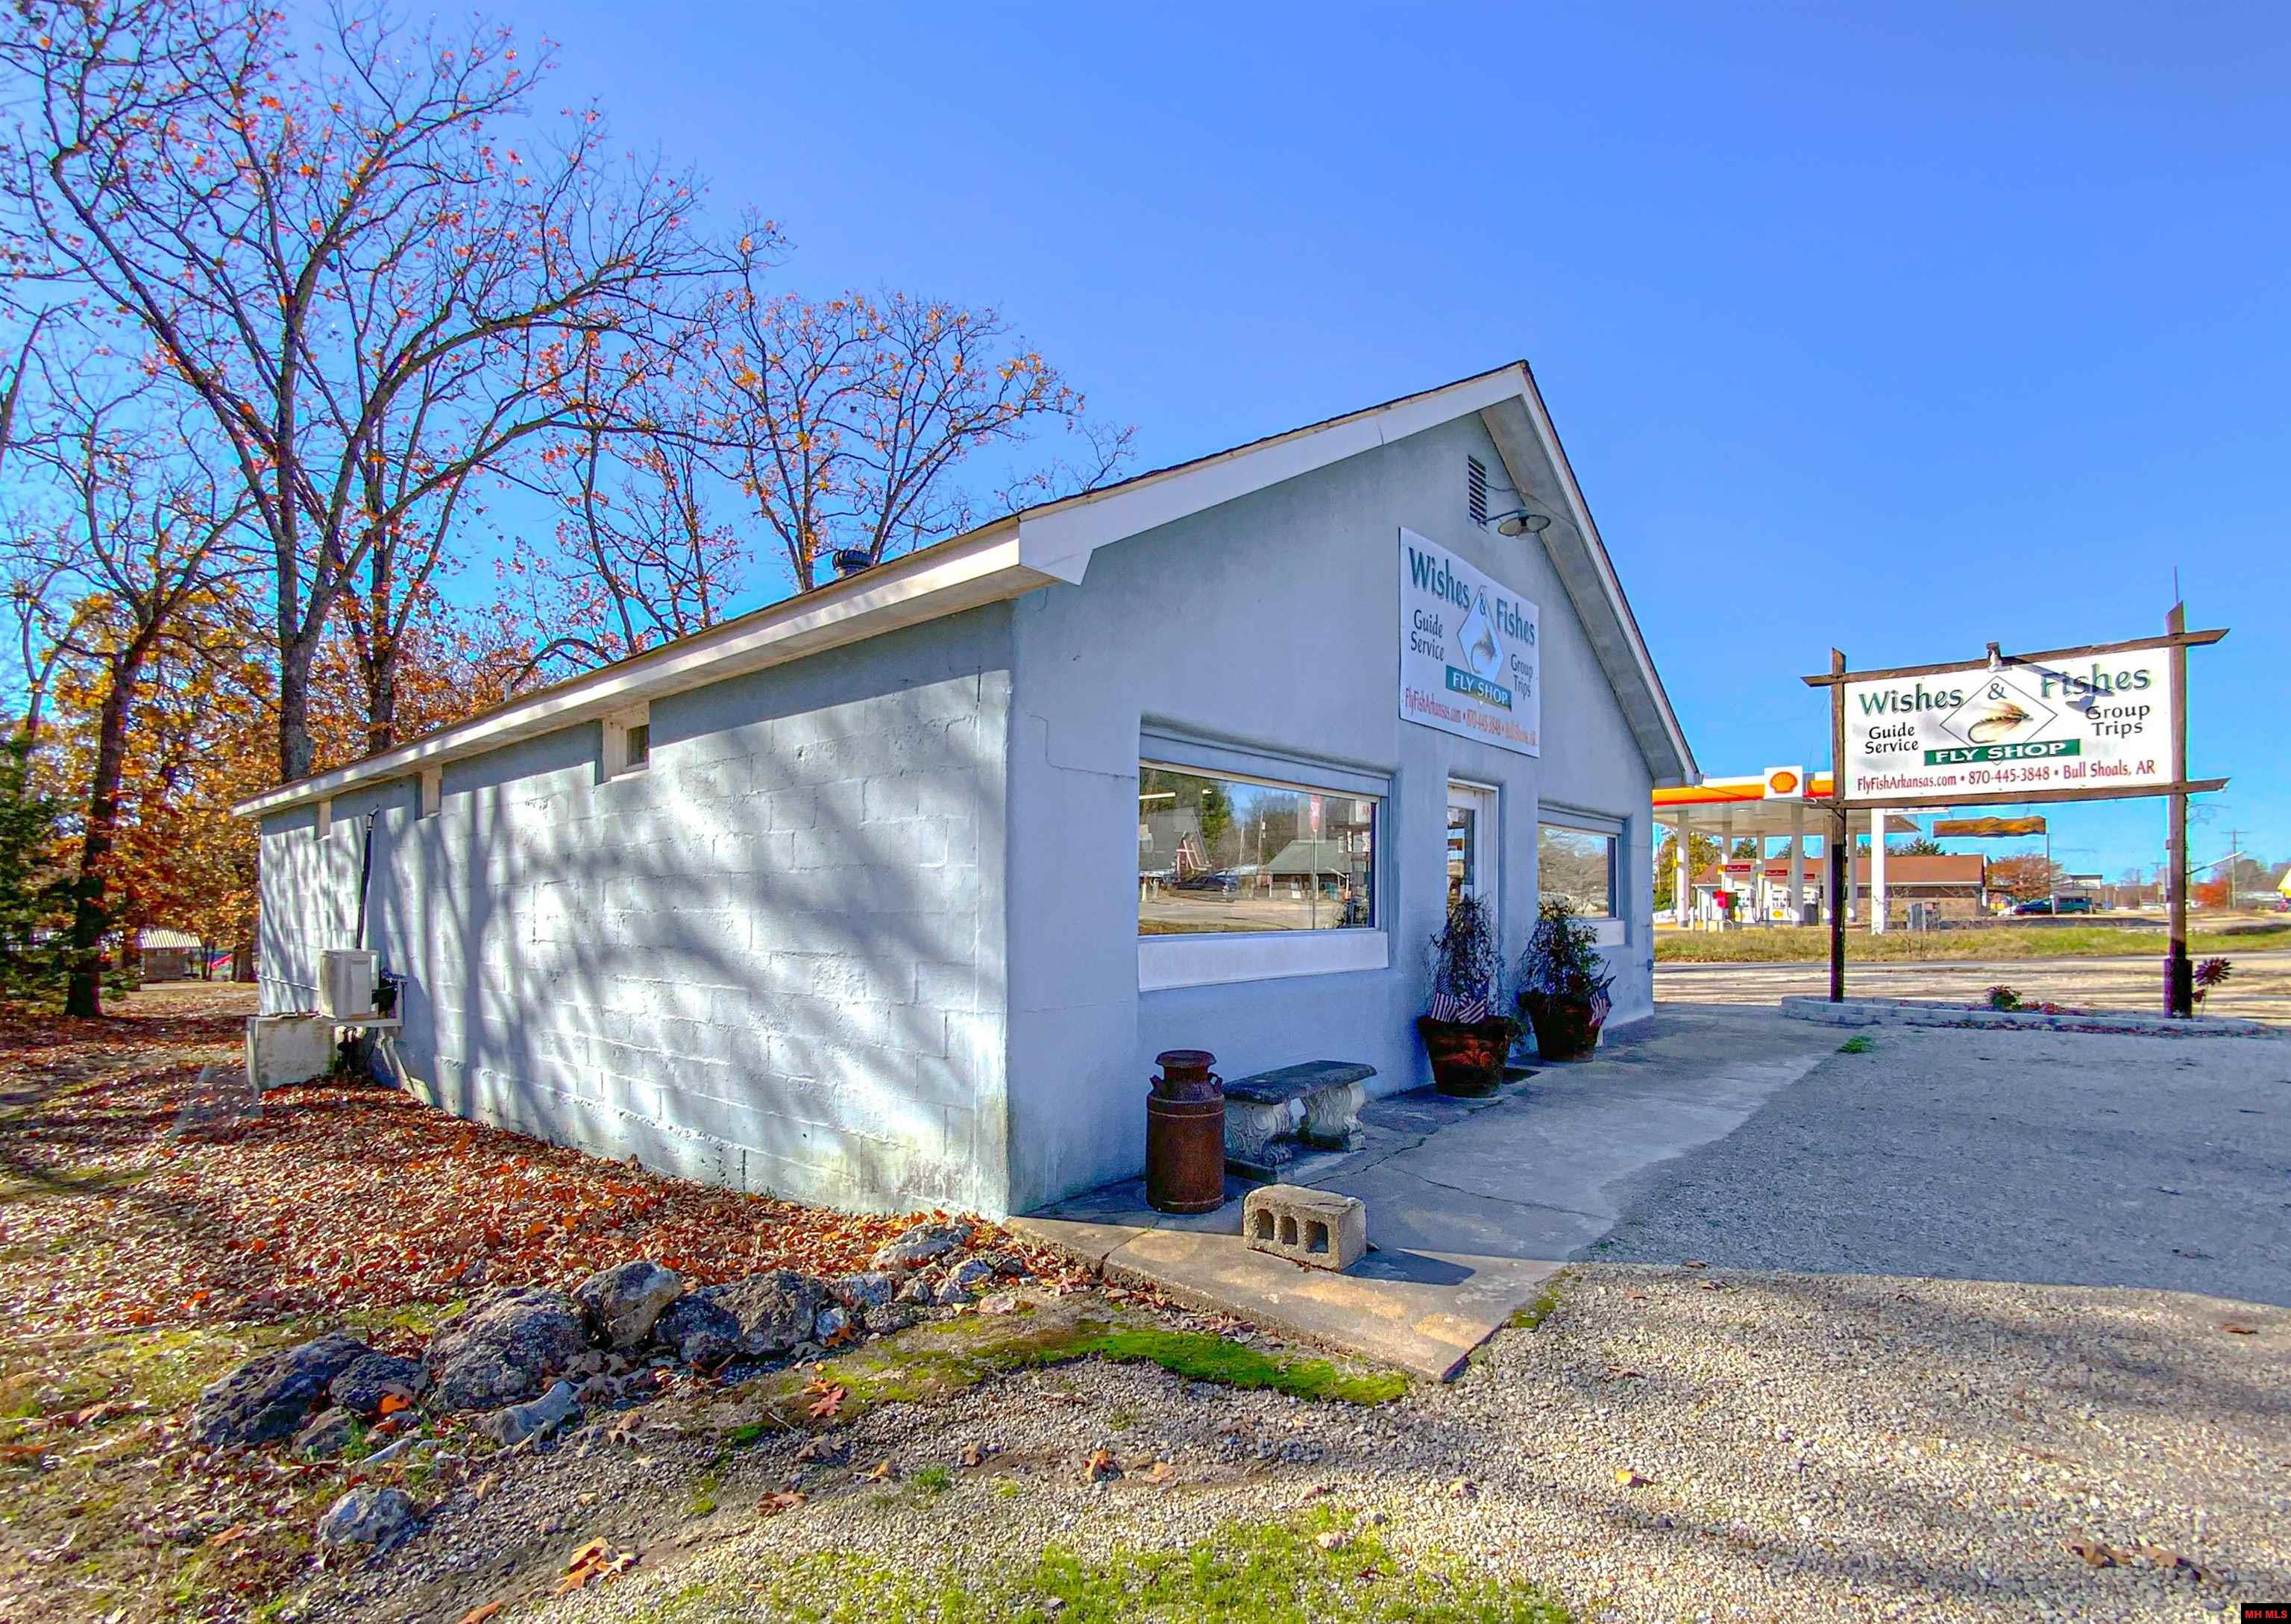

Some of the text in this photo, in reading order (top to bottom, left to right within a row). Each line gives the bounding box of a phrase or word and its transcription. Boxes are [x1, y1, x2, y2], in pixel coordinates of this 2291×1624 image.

[1408, 546, 1535, 647] Wishes & Fishes
[1414, 609, 1444, 639] Guide
[1410, 631, 1445, 662] Service
[1510, 653, 1534, 682] Group
[1453, 673, 1508, 705] FLY SHOP
[1513, 674, 1531, 701] Trips
[1859, 663, 2152, 717] Wishes & Fishes
[2085, 704, 2150, 721] Group
[1868, 722, 1915, 740] Guide
[2091, 720, 2143, 739] Trips
[1864, 739, 1919, 755] Service
[1935, 743, 2067, 764] FLY SHOP
[1857, 758, 2156, 795] FlyFishArkansas.com 870-445-3848 Bull Shoals, AR
